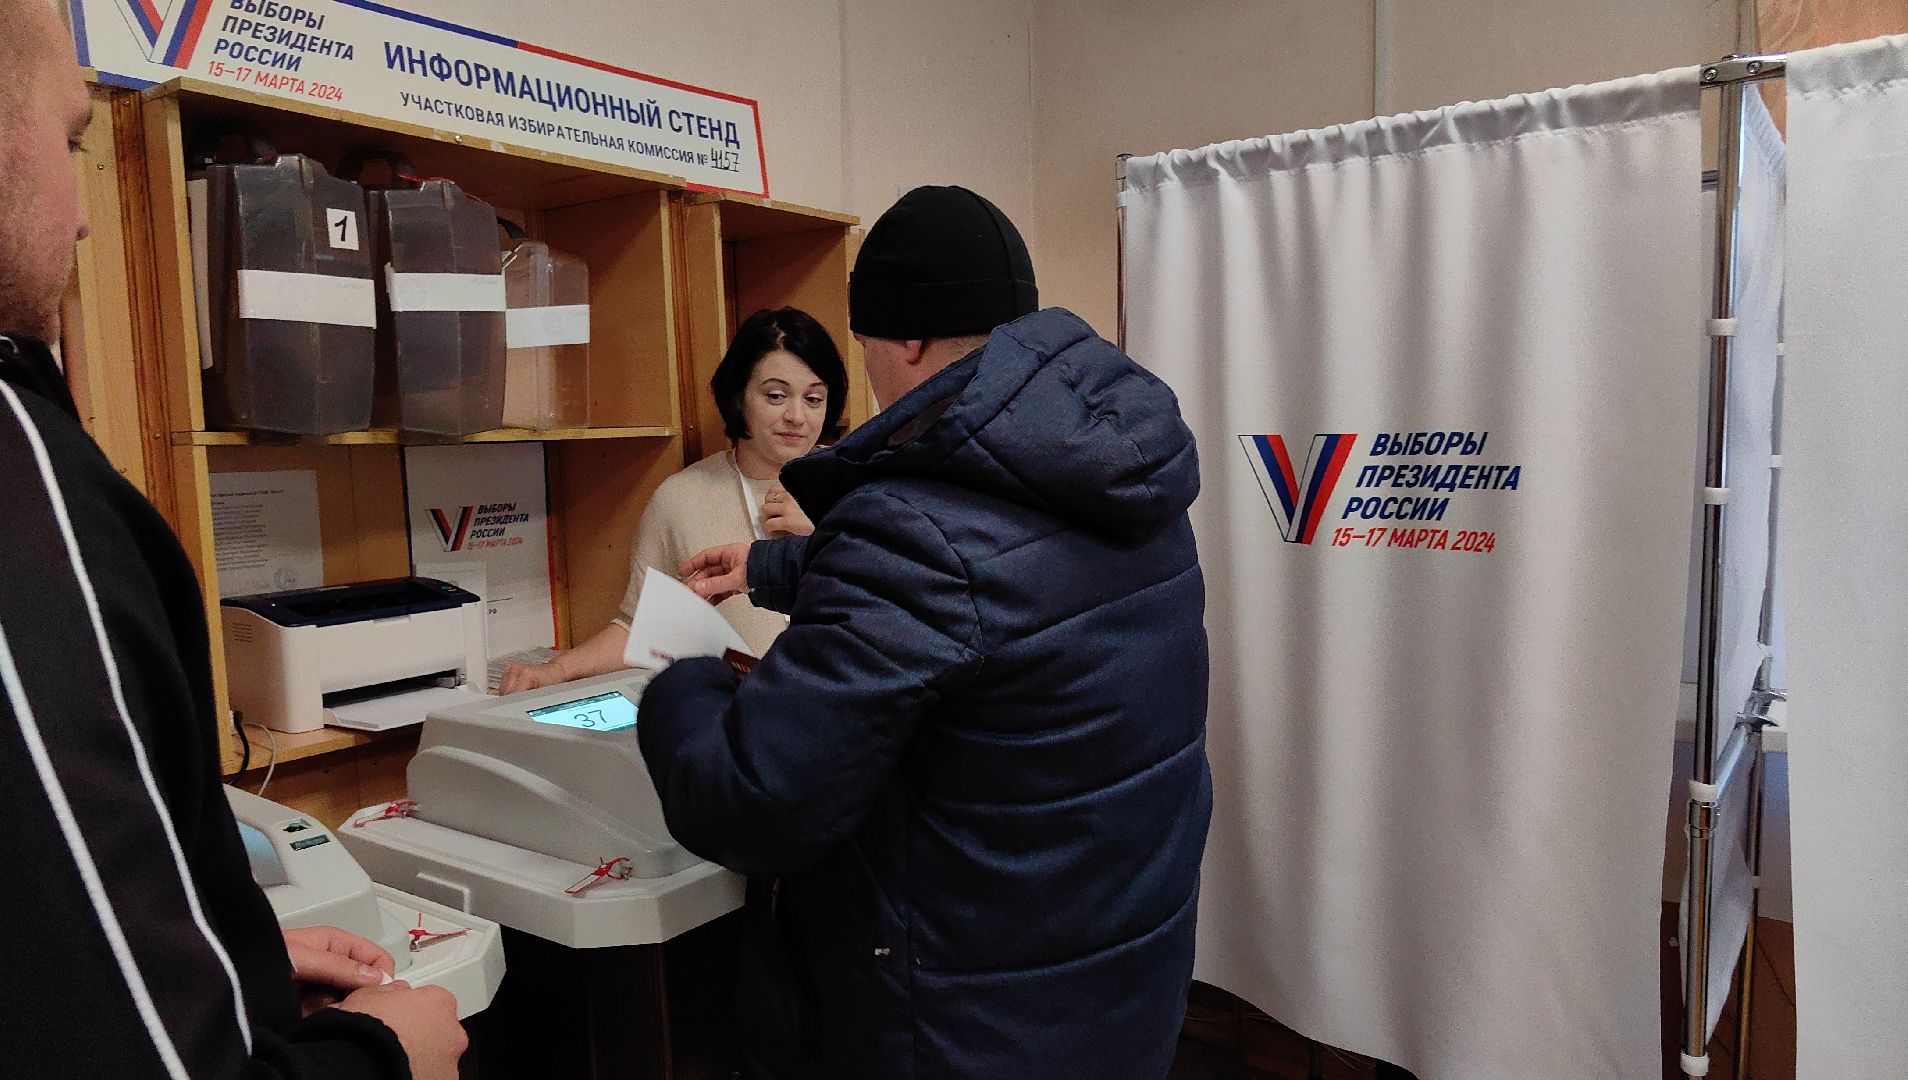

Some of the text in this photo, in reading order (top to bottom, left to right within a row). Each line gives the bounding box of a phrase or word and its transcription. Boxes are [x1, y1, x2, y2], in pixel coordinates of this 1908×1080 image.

[230, 0, 325, 30] ВЫБОРЫ
[221, 15, 354, 60] ПРЕЗИДЕНТА
[213, 38, 303, 72] РОССИИ
[254, 70, 305, 95] МАРТА
[308, 82, 343, 101] 2024
[384, 41, 741, 150] ИНФОРМАЦИОННЫЙ СТЕНД
[400, 91, 505, 127] УЧАСТКОВАЯ
[508, 115, 625, 151] ИЗБИРАТЕЛЬНАЯ
[627, 139, 695, 164] КОМИССИЯ
[711, 148, 739, 172] 4157
[335, 215, 348, 242] 1
[1369, 431, 1489, 456] ВЫБОРЫ
[1355, 464, 1522, 492] ПРЕЗИДЕНТА
[473, 513, 530, 527] ПРЕЗИДЕНТА
[477, 501, 517, 515] ВЫБОРЫ
[1341, 496, 1450, 521] РОССИИ
[469, 527, 506, 539] РОССИИ
[1387, 528, 1448, 551] МАРТА
[1450, 531, 1497, 553] 2024
[574, 709, 608, 728] 37
